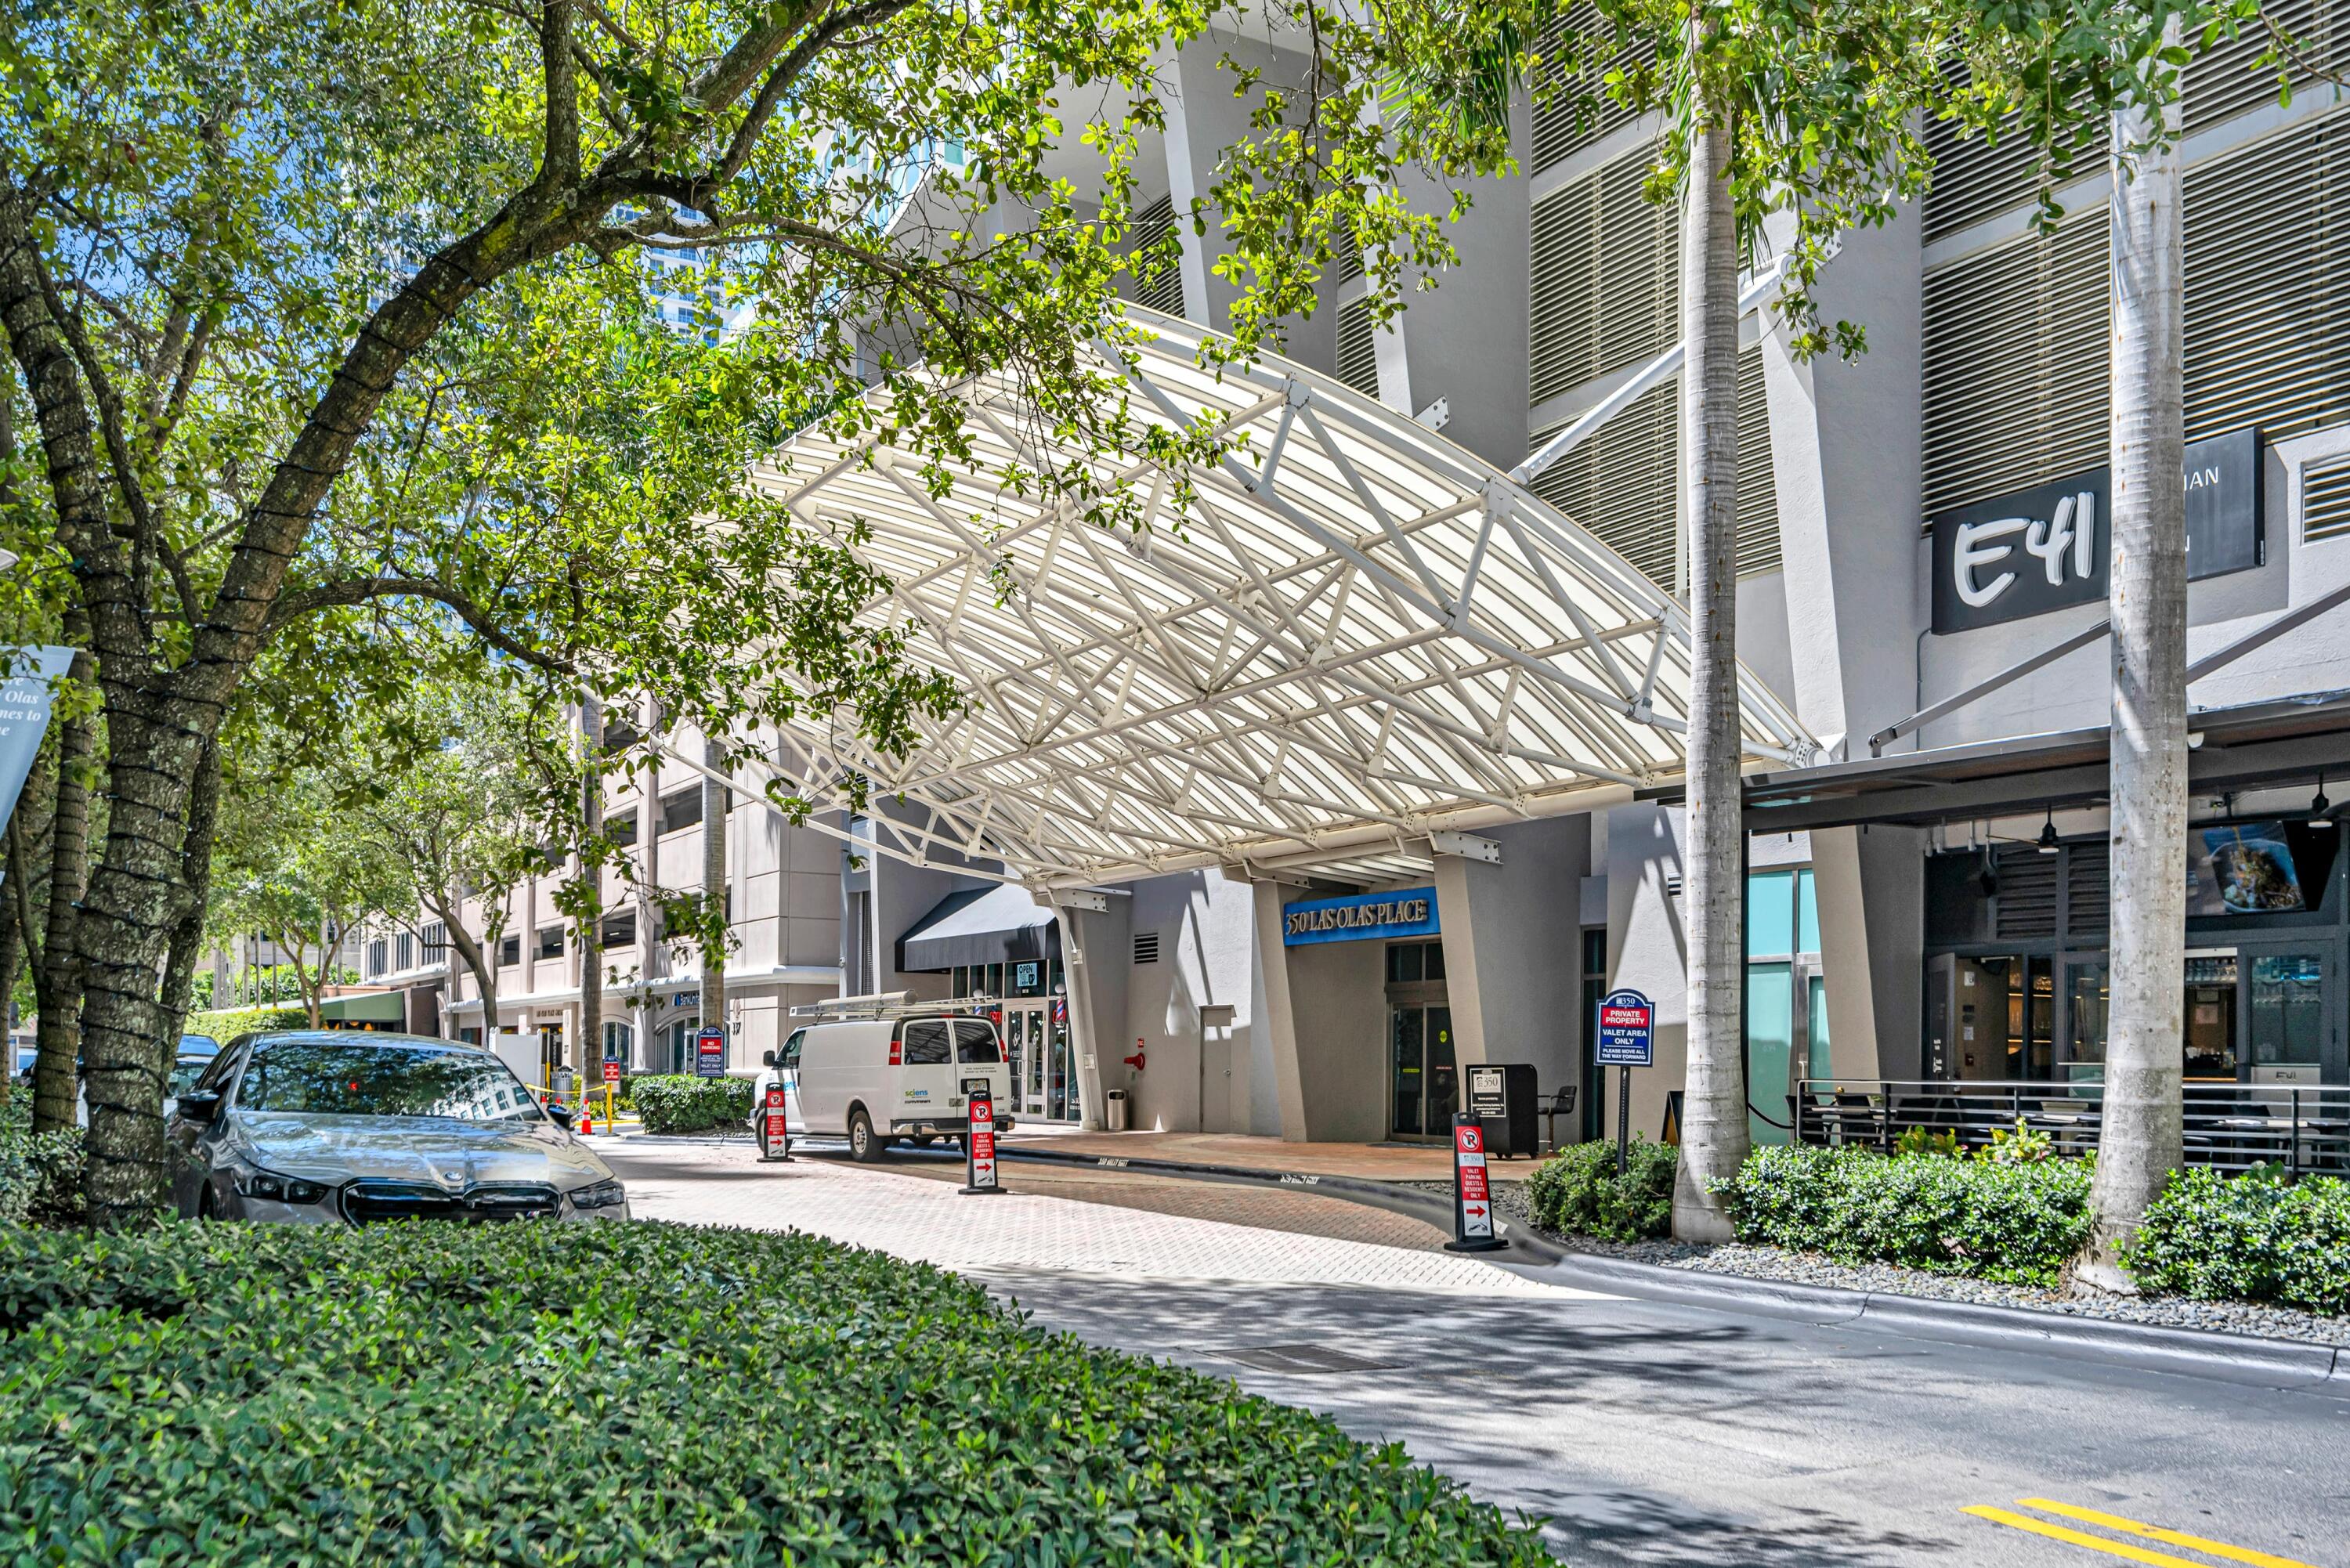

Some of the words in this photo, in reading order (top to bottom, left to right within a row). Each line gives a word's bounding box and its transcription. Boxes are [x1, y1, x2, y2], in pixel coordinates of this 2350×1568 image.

[5, 690, 38, 704] Olas
[27, 709, 42, 721] to
[1285, 912, 1307, 935] 350
[1309, 909, 1335, 931] LAS
[1336, 904, 1375, 929] OLAS
[1376, 899, 1427, 925] PLACE
[1019, 965, 1033, 974] OPEN
[1484, 1076, 1498, 1088] 350
